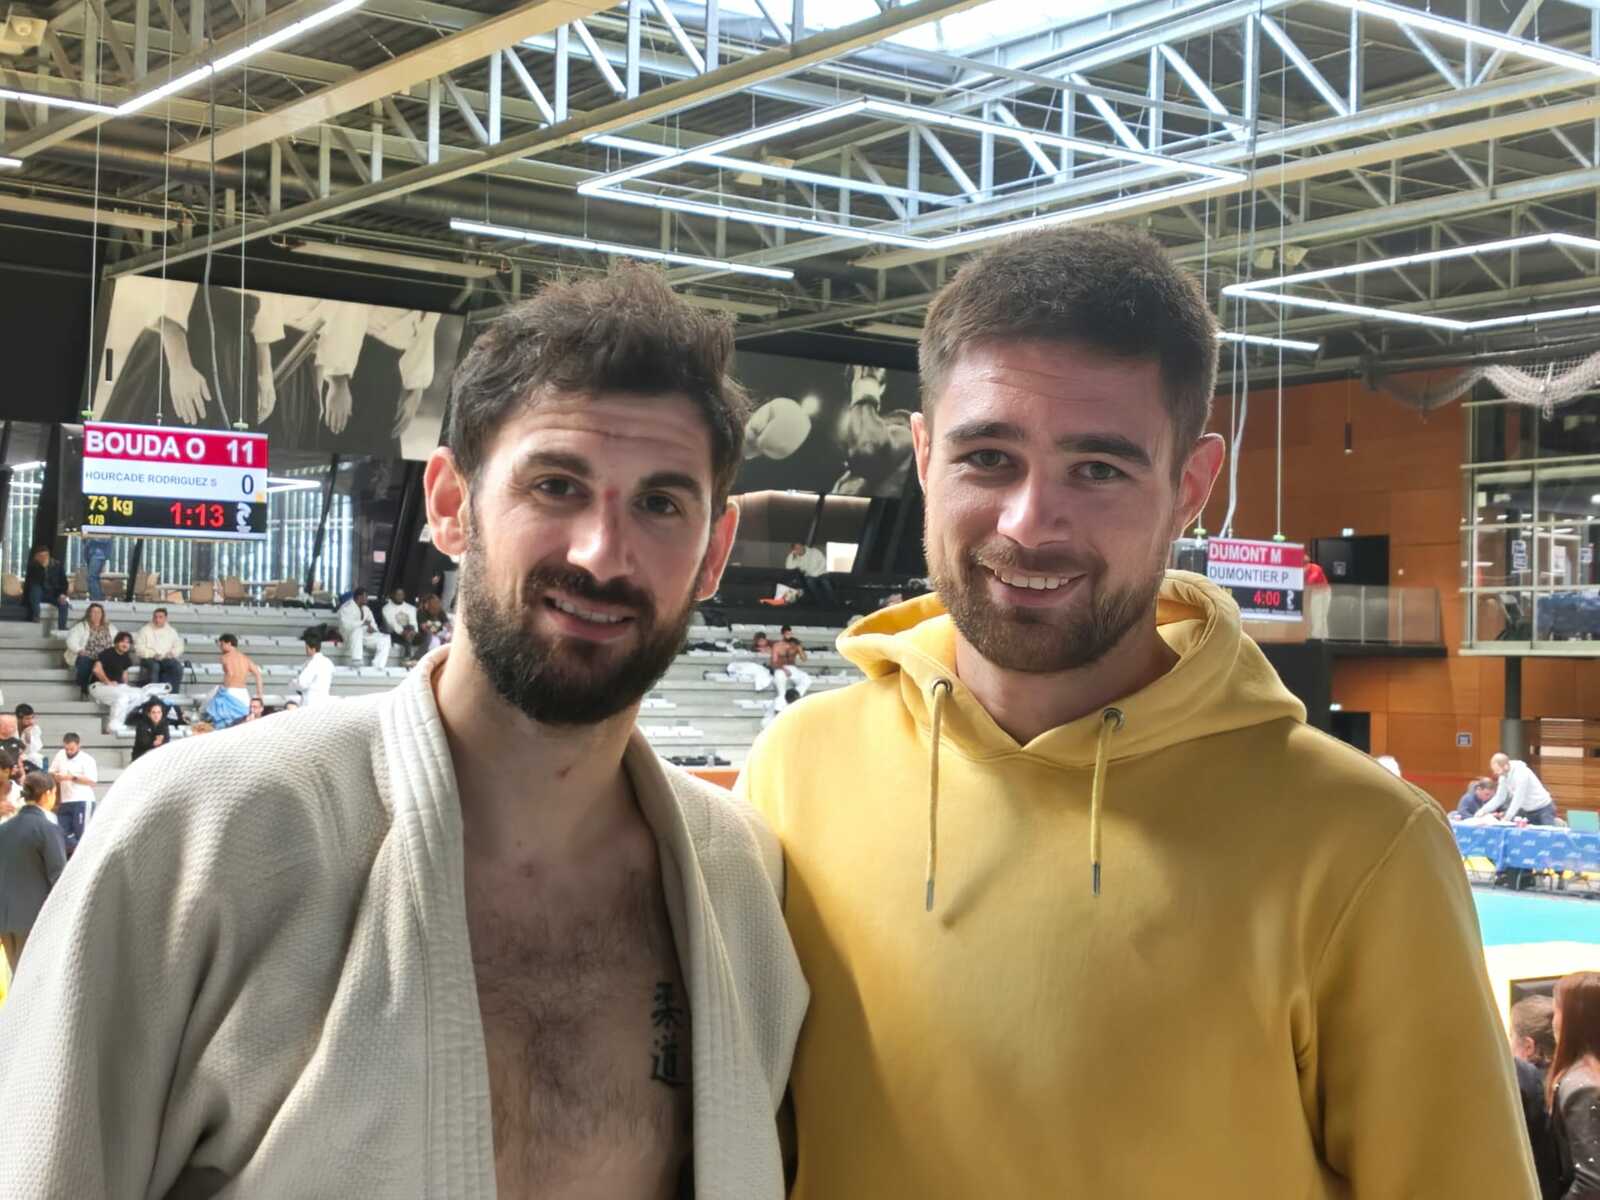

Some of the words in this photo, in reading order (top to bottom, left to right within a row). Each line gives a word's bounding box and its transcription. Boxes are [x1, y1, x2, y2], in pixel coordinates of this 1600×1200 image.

[86, 431, 180, 458] BOUDA
[186, 438, 205, 459] O
[226, 440, 253, 464] 11
[86, 471, 145, 484] HOURCADE
[148, 474, 208, 487] RODRIGUEZ
[241, 474, 254, 495] 0
[88, 495, 108, 511] 73
[112, 497, 134, 515] kg
[171, 502, 224, 527] 1:13
[88, 514, 105, 526] 1/8
[1210, 543, 1268, 562] DUMONT
[1271, 548, 1282, 563] M
[1210, 566, 1278, 583] DUMONTIER
[1281, 573, 1289, 584] P
[1253, 591, 1280, 606] 4:00
